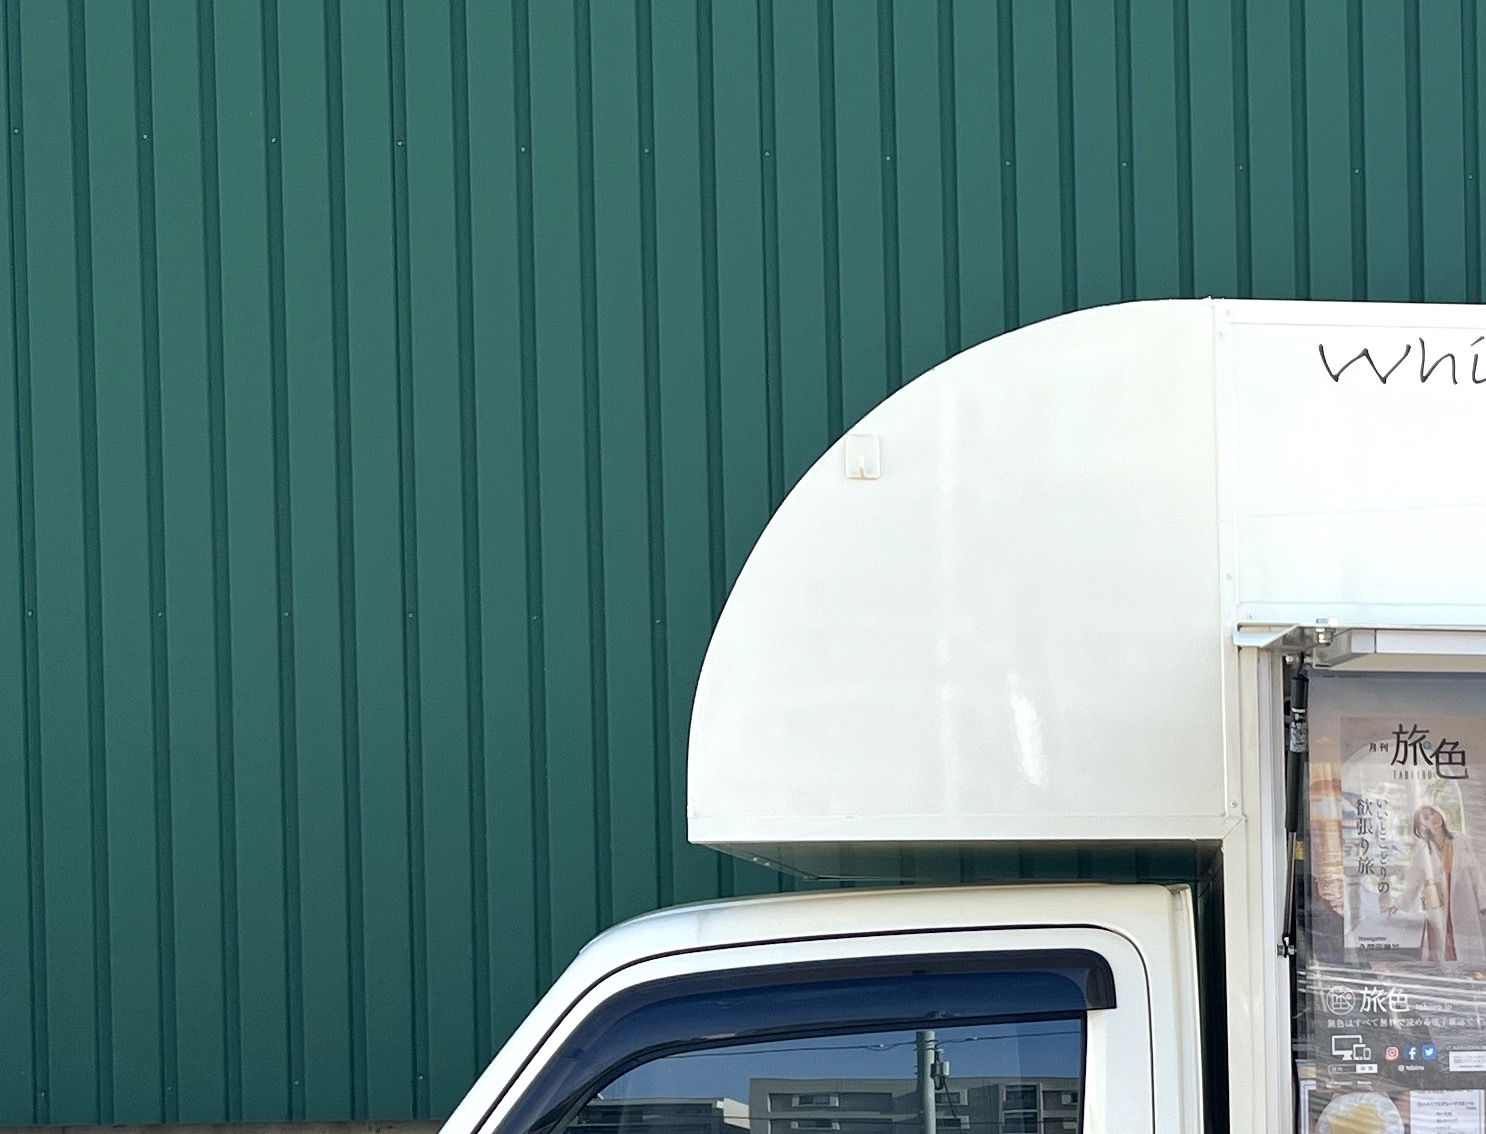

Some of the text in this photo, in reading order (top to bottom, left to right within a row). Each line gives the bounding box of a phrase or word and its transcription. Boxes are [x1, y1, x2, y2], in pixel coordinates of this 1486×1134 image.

[1391, 723, 1468, 780] 旅色
[1357, 798, 1375, 875] 欲張り旅
[1359, 986, 1409, 1013] 旅色
